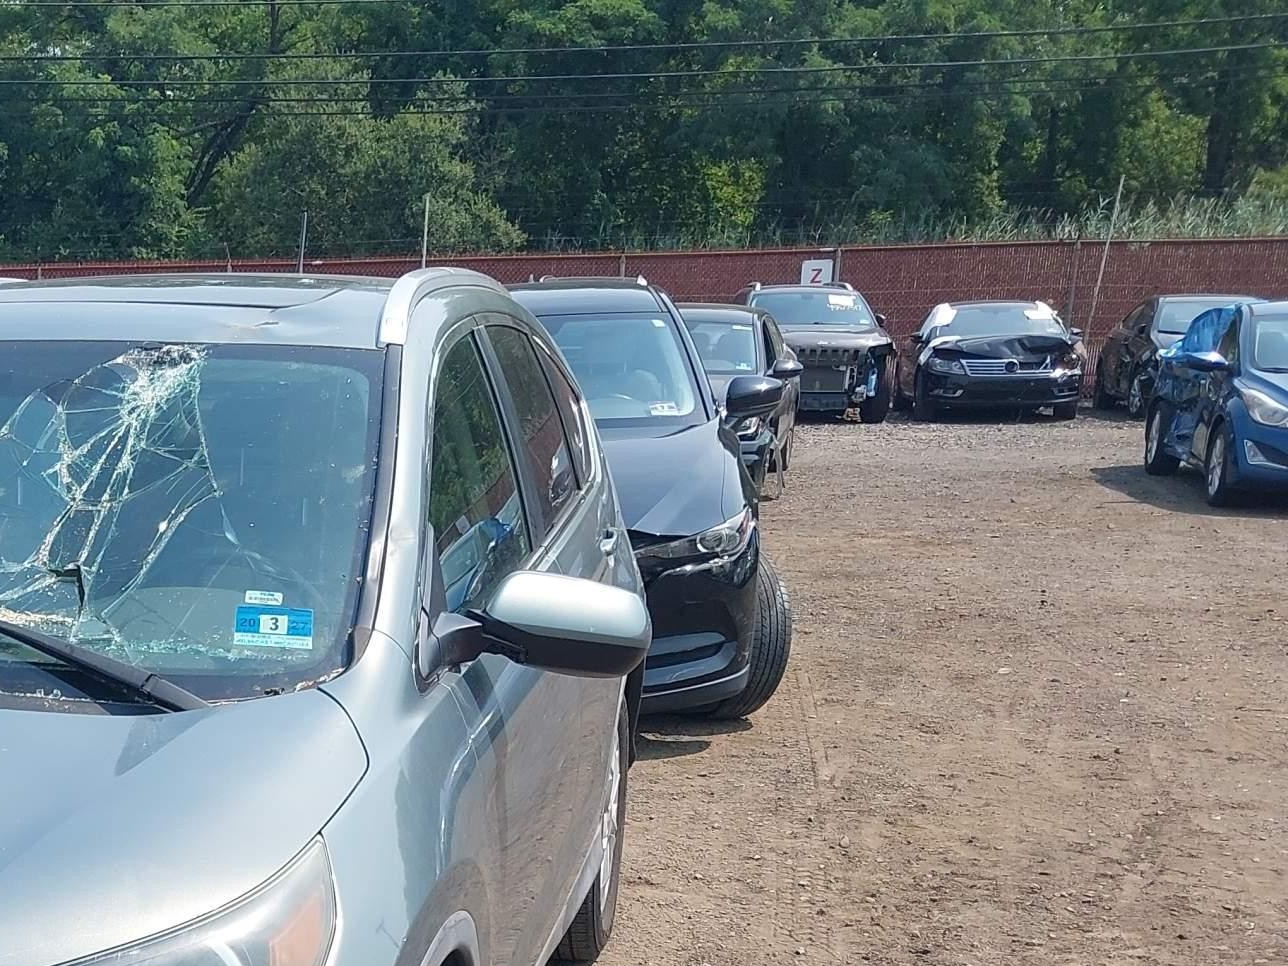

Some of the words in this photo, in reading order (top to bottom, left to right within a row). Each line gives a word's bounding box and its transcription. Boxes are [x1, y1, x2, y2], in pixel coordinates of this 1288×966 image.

[809, 268, 823, 284] Z
[239, 617, 256, 628] 20
[269, 616, 279, 631] 3
